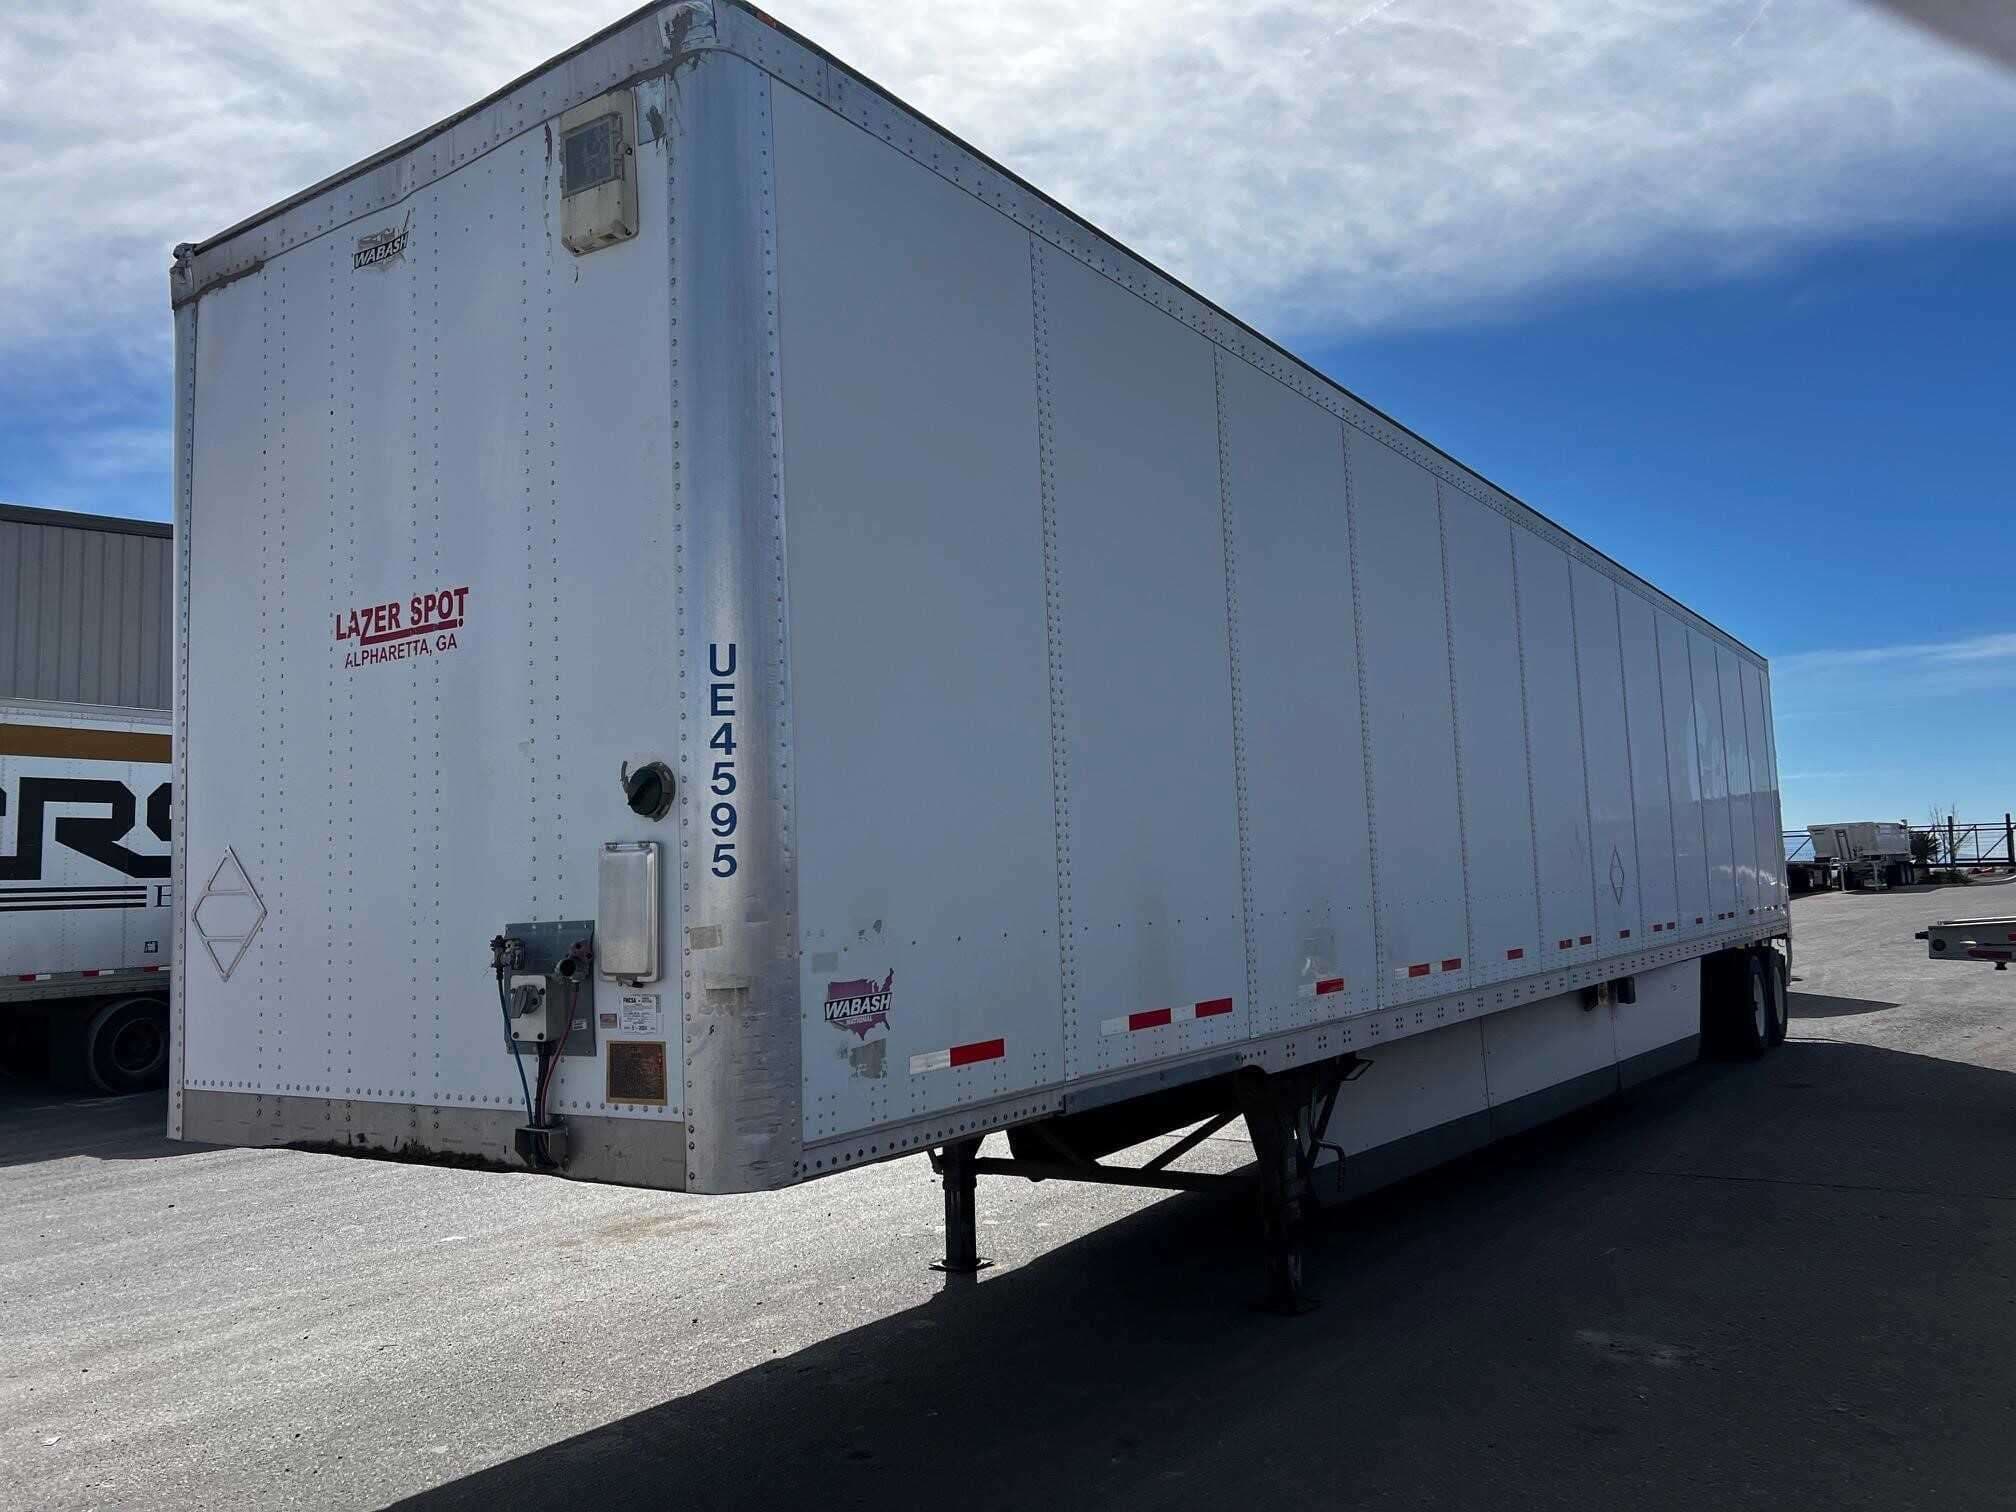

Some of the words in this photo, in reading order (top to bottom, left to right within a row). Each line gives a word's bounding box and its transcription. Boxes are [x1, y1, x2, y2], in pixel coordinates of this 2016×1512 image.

[354, 231, 409, 269] WABASH
[336, 602, 401, 646] LAZER
[344, 638, 432, 669] ALPHARETTA,
[435, 633, 458, 651] GA
[709, 643, 738, 878] UE4595
[825, 993, 891, 1019] WABASH
